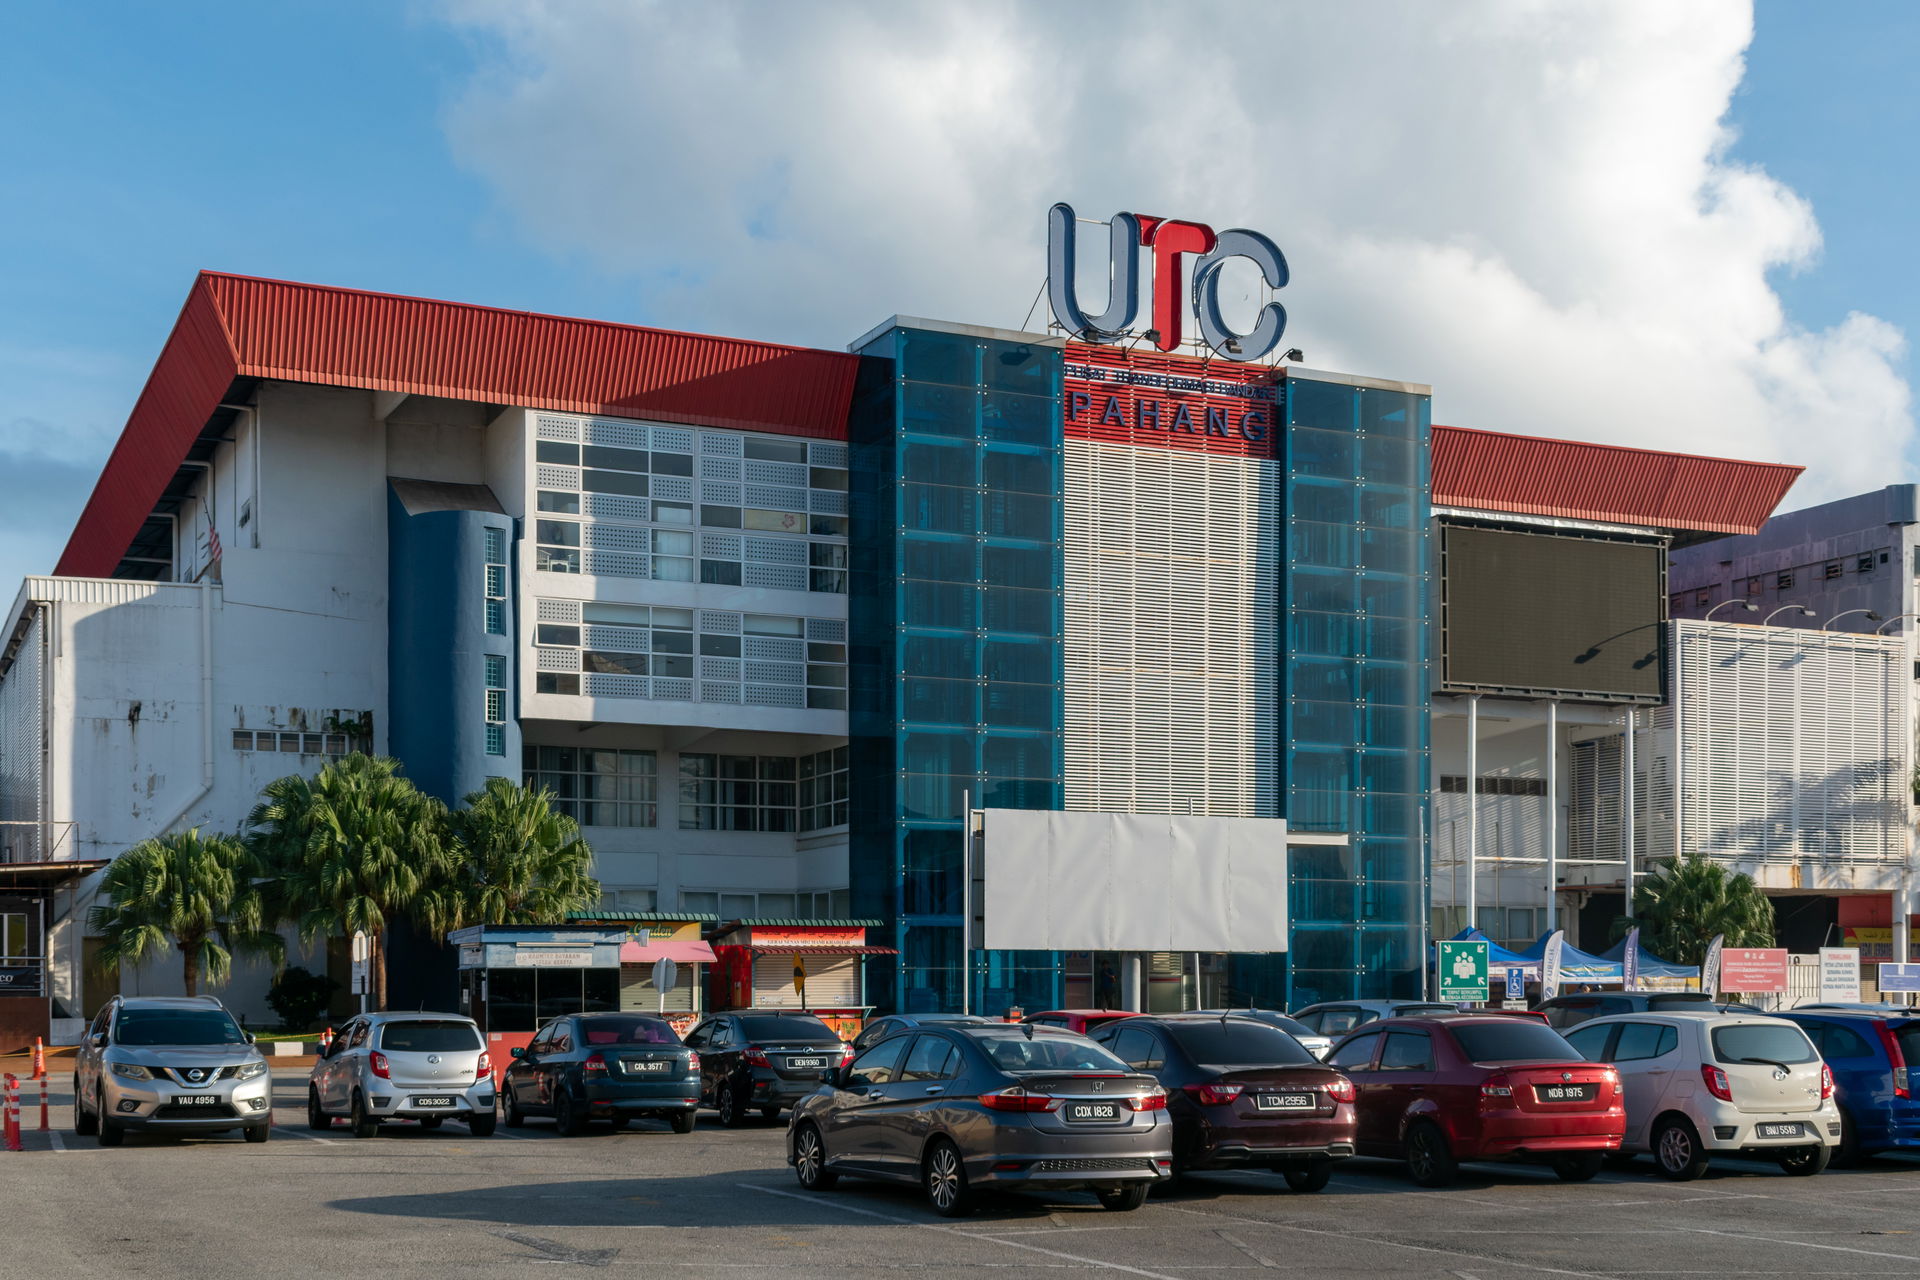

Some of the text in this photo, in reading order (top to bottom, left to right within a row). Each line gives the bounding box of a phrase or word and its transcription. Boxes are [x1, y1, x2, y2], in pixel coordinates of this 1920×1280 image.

[1048, 202, 1290, 361] UTC
[1063, 363, 1107, 381] PUSAT
[1070, 391, 1266, 441] PAHANG
[1547, 948, 1555, 982] ZURICH
[1513, 969, 1518, 977] P
[634, 1063, 647, 1071] CDL
[1548, 1087, 1584, 1098] NDB 1975
[178, 1096, 216, 1105] VAU 4956
[418, 1098, 450, 1106] CDS 3022
[1267, 1095, 1307, 1107] TCM 2956
[1074, 1105, 1093, 1118] CDX
